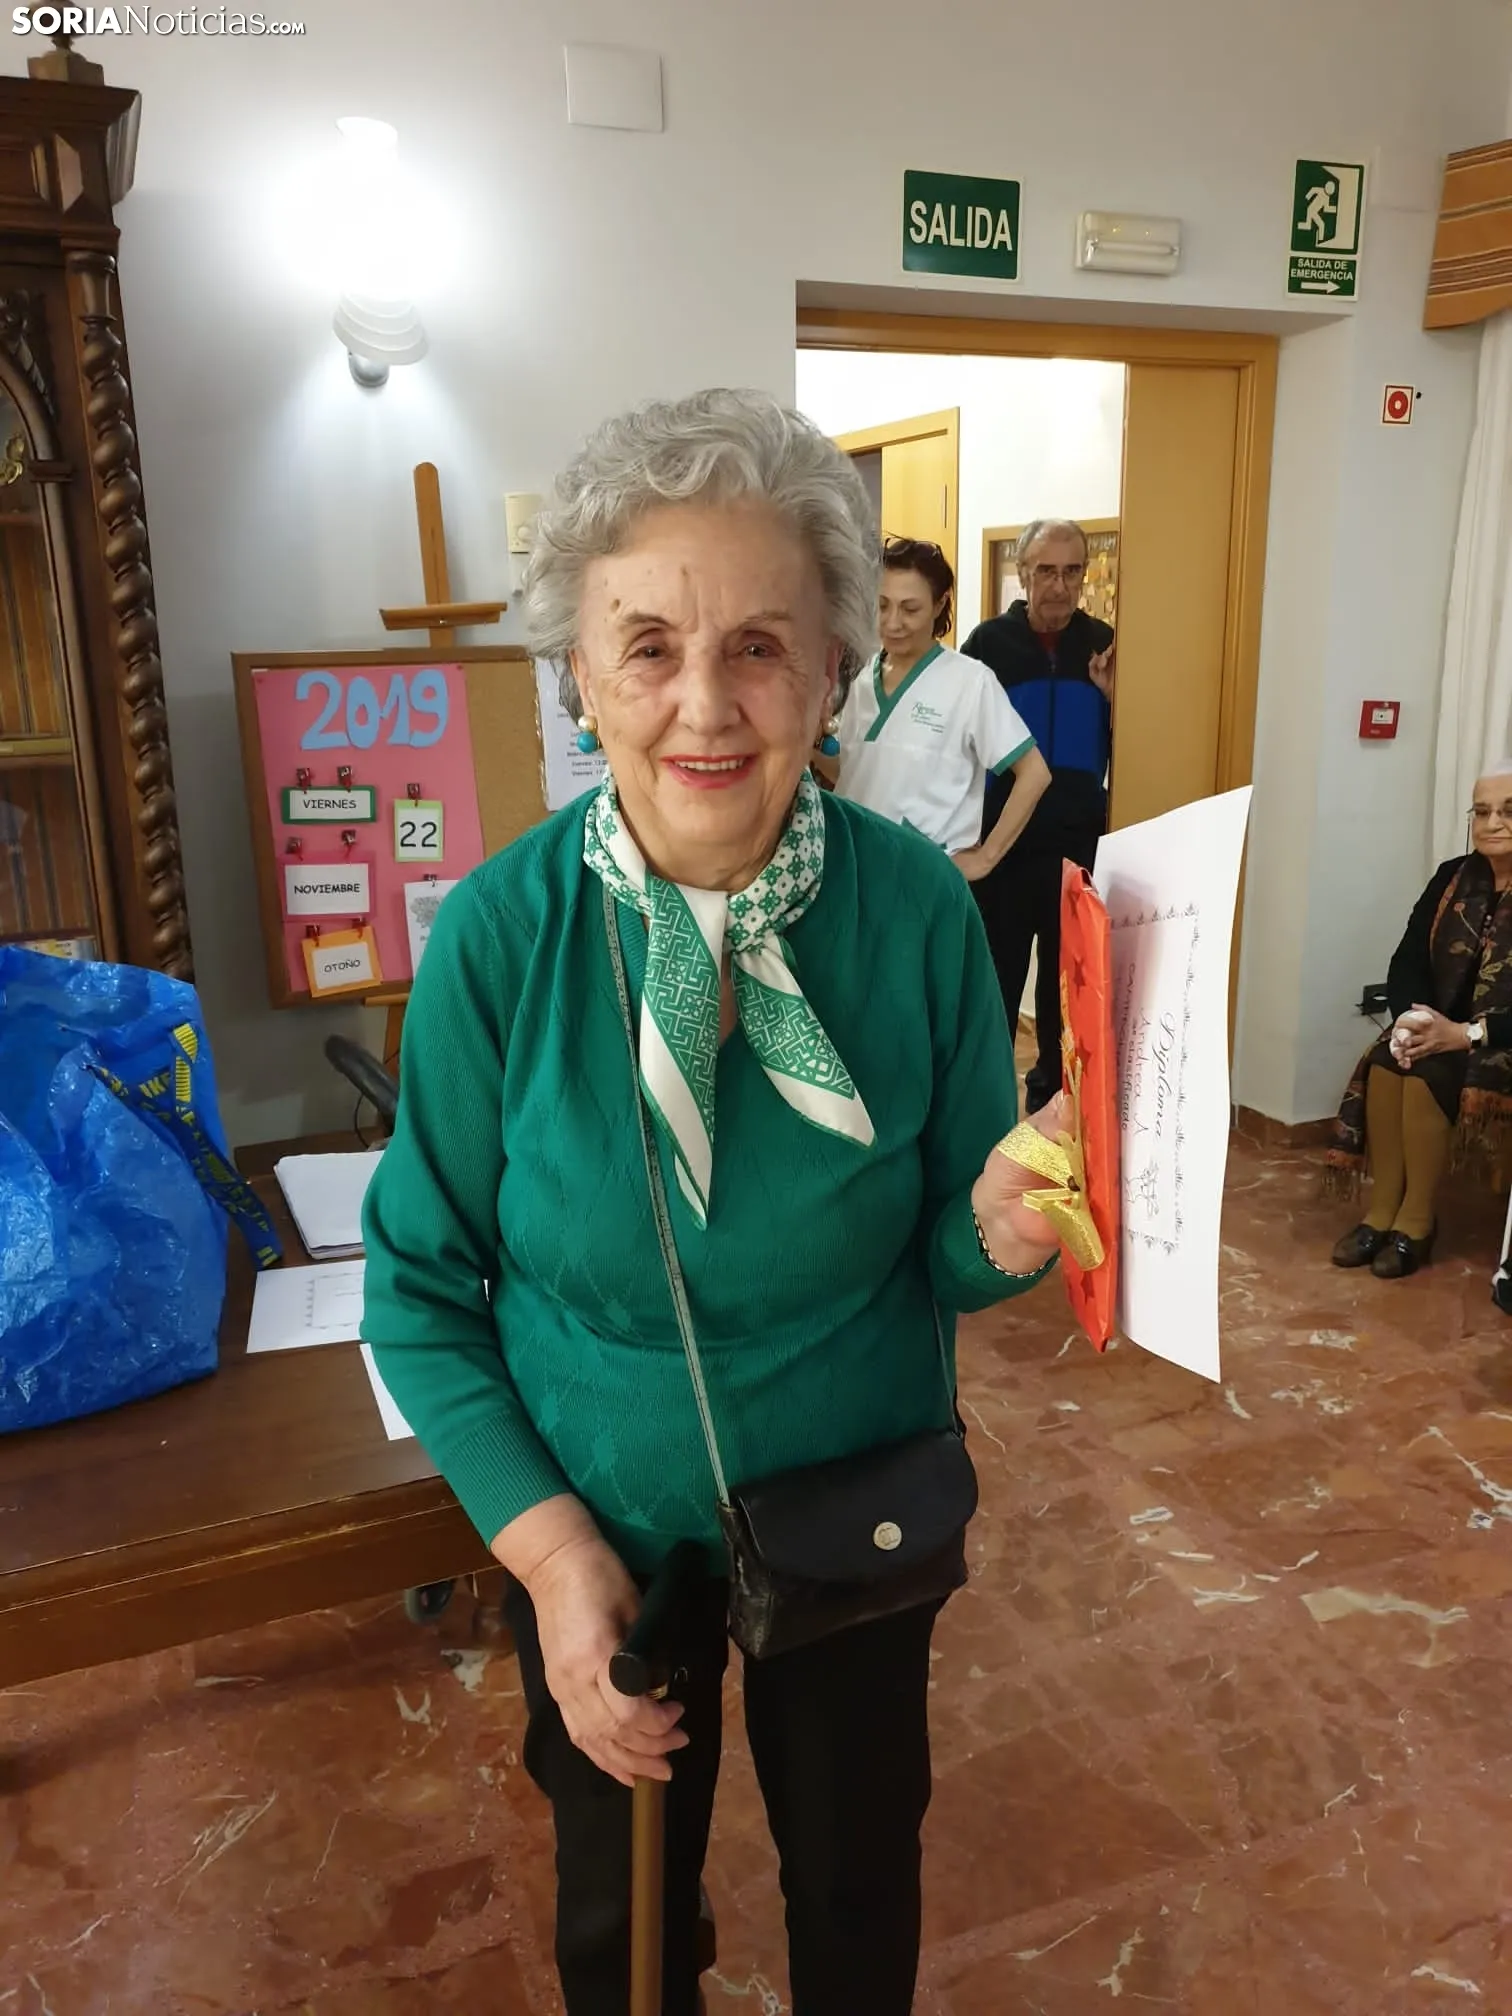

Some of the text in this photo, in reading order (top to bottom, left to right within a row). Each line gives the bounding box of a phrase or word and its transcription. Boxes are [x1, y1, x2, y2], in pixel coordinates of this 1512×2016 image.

[909, 200, 1013, 251] SALIDA
[1290, 268, 1353, 280] EMERGENCIA
[1297, 258, 1348, 270] SALIDA DE
[296, 669, 449, 751] 2019
[303, 799, 357, 809] VIERNES
[400, 821, 437, 847] 22
[294, 883, 361, 894] NOVIEMBRE
[324, 958, 361, 973] OTOÑO
[1134, 1007, 1151, 1097] Andrea
[1151, 1012, 1176, 1137] Diploma
